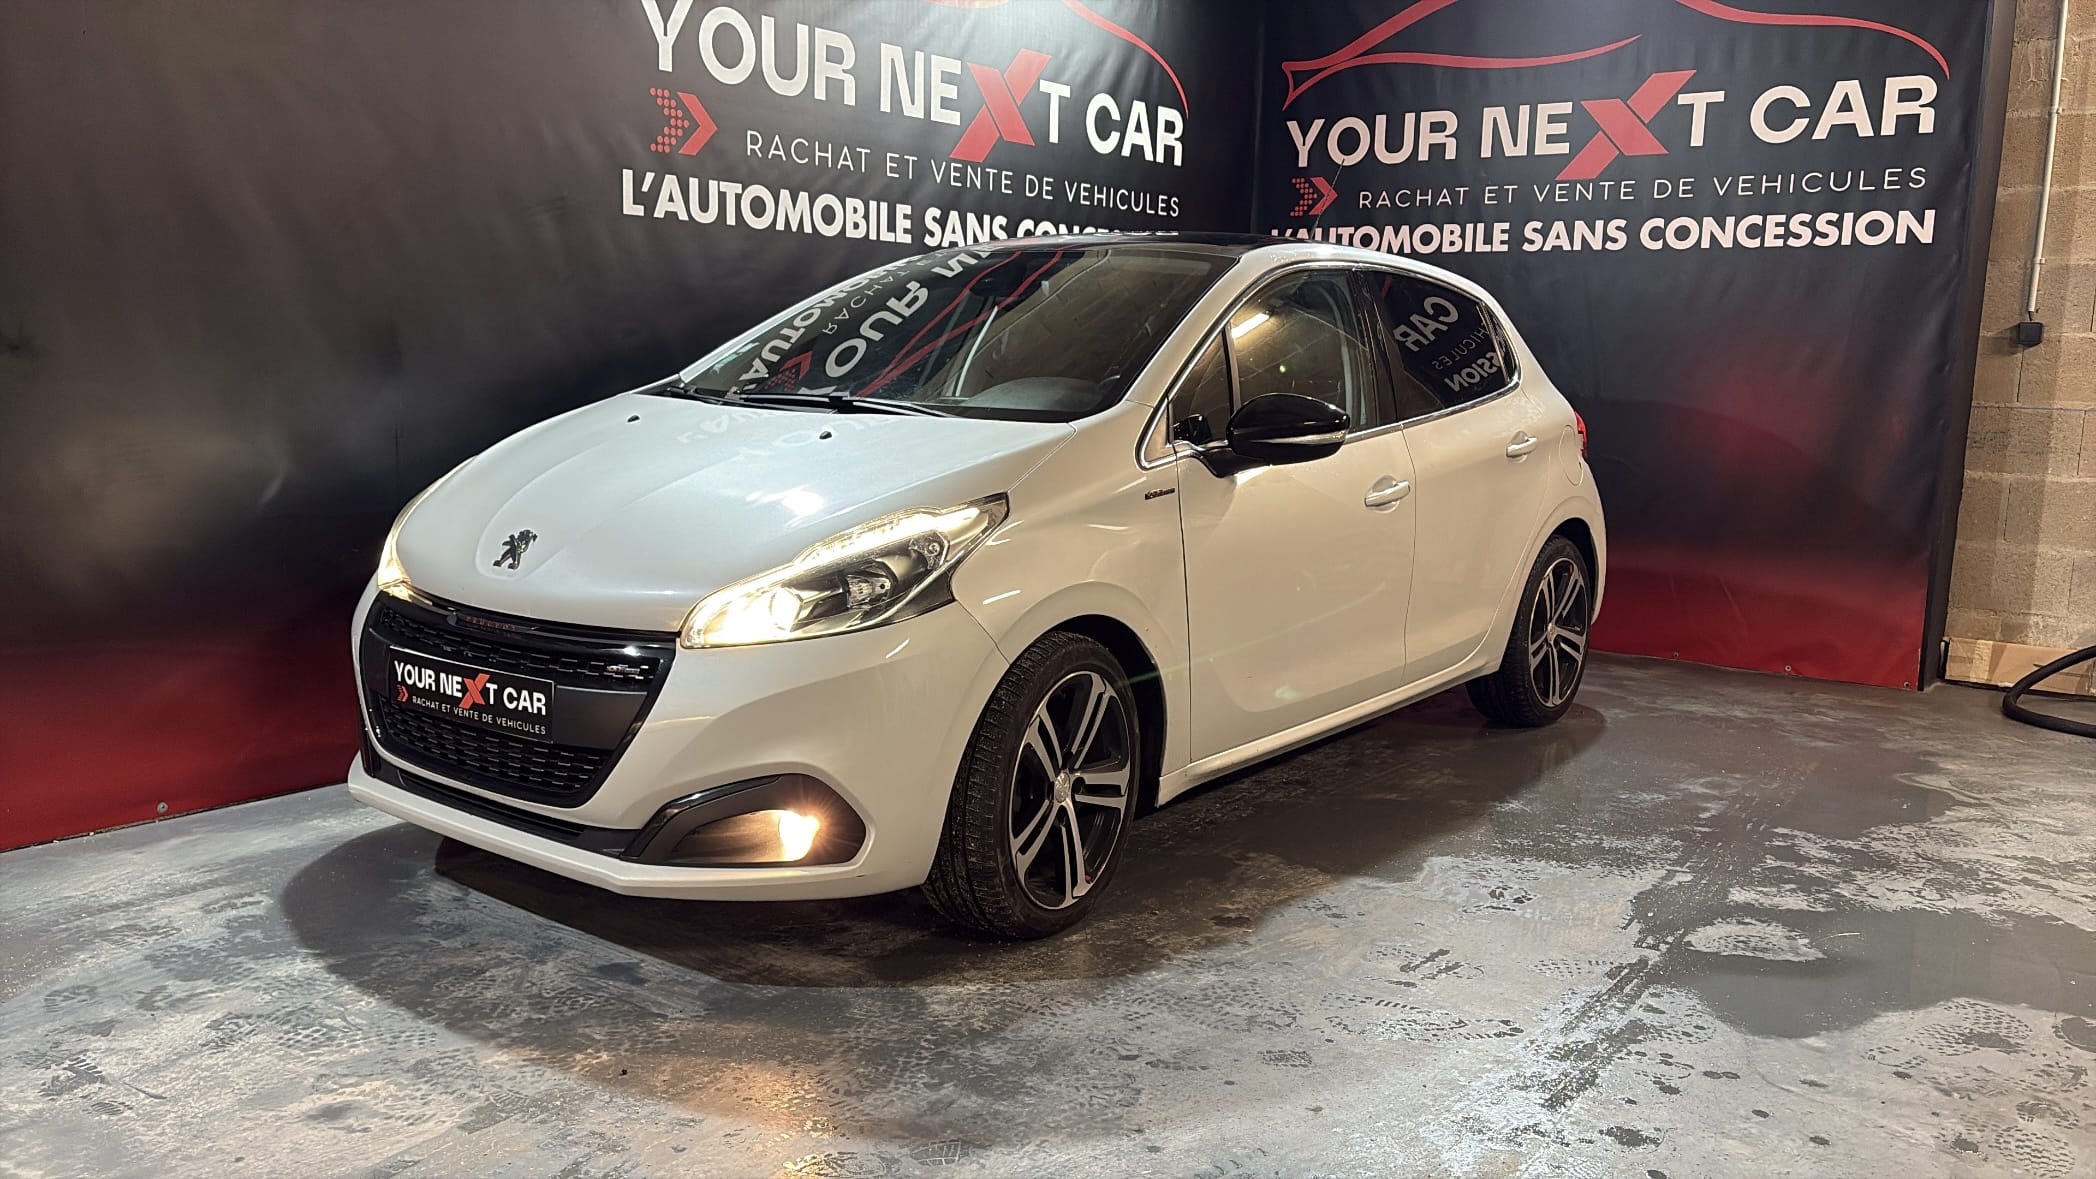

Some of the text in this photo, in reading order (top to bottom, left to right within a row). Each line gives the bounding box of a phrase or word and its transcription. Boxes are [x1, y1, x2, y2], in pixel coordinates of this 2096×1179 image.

[640, 0, 1184, 167] YOUR NEXT CAR
[1286, 70, 1938, 180] YOUR NEXT CAR
[746, 130, 1180, 217] RACHAT ET VENTE DE VEHICULES
[1359, 167, 1926, 209] RACHAT ET VENTE DE VEHICULES
[622, 168, 1008, 247] L'AUTOMOBILE SANS
[1522, 217, 1628, 251] SANS
[1640, 209, 1936, 249] CONCESSION
[394, 660, 547, 716] YOUR NEXT CAR
[412, 695, 546, 735] RACHAT ET VENTE DE VEHICULES
